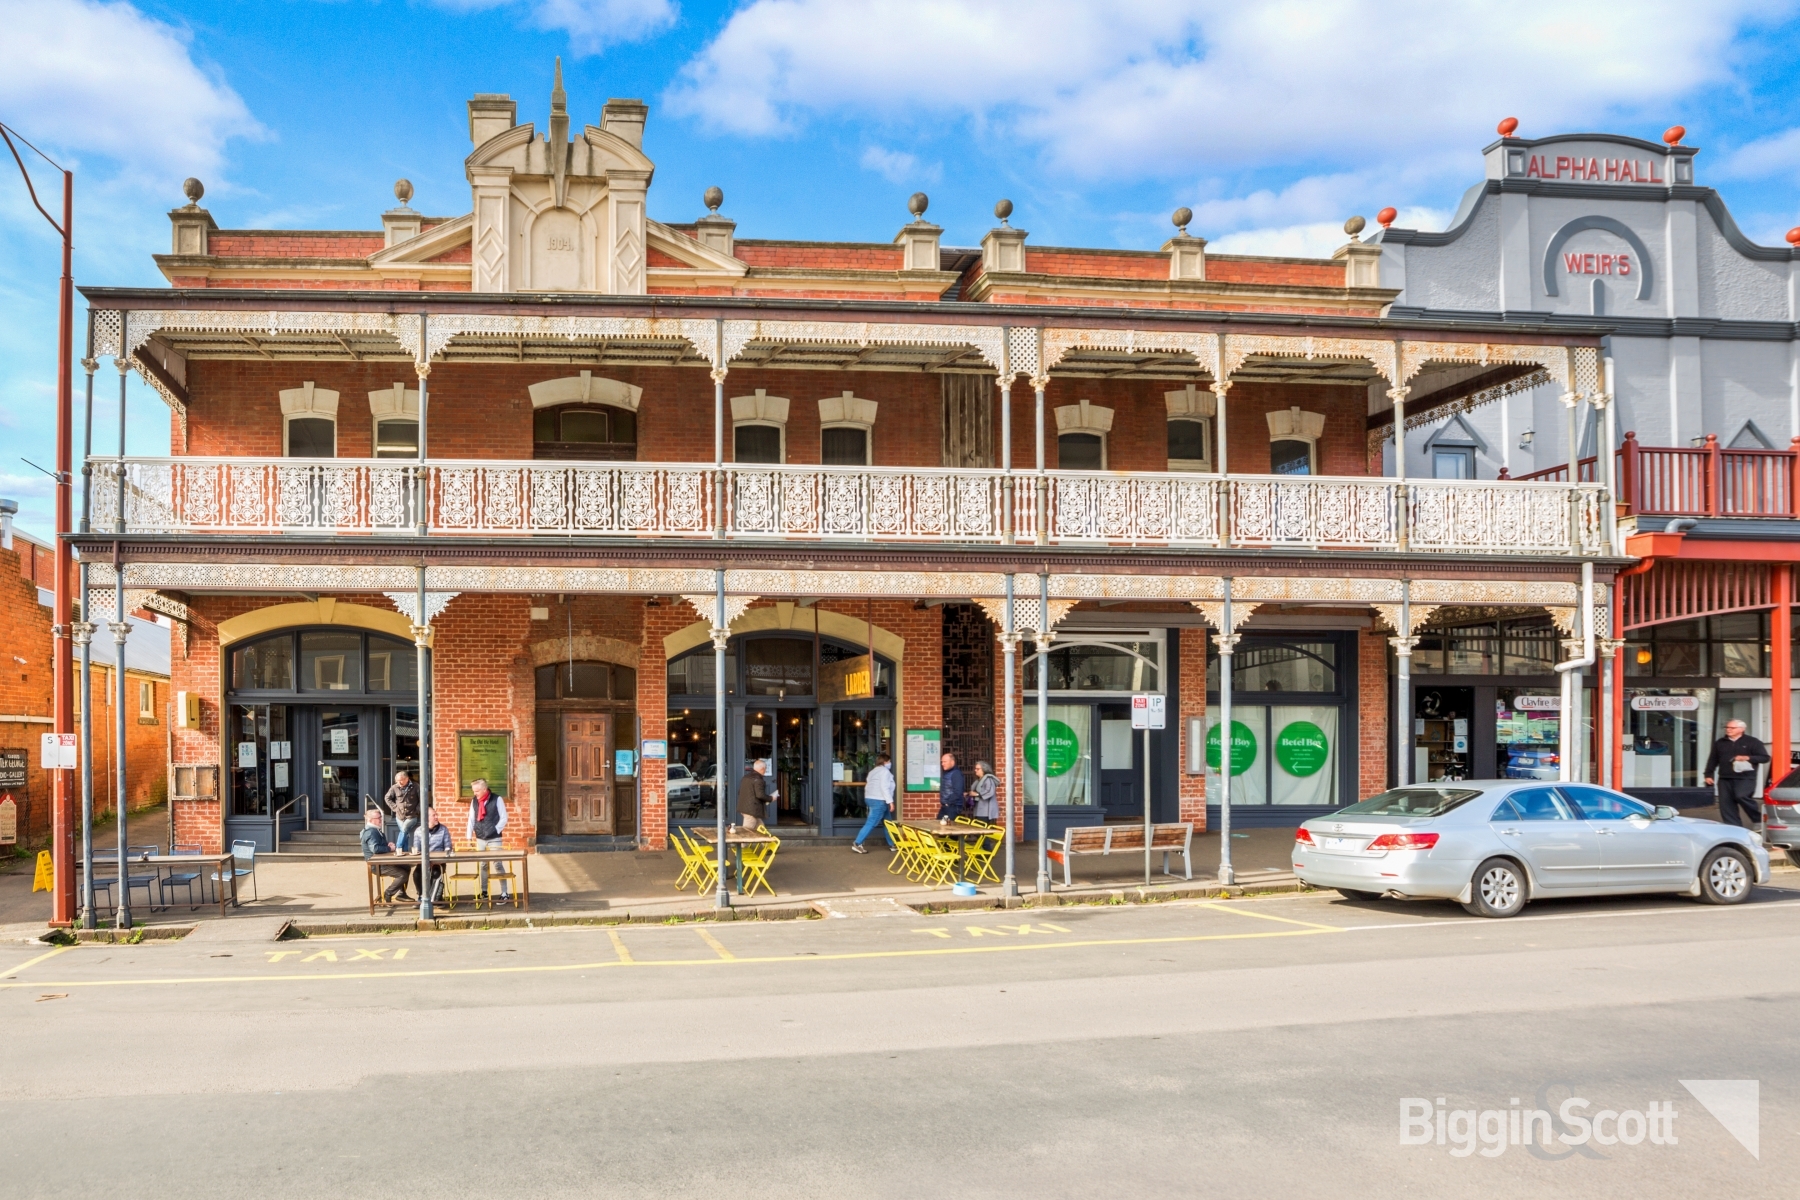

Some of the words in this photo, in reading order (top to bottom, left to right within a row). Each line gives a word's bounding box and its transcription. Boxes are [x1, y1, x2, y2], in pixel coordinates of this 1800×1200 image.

[1527, 155, 1600, 181] ALPHA
[1603, 158, 1663, 183] HALL
[1563, 253, 1631, 275] WEIR'S
[845, 670, 870, 695] LARDER
[1521, 697, 1550, 707] Clayfire
[1638, 697, 1667, 707] Clayfire
[1056, 737, 1073, 748] Boy
[1234, 738, 1251, 748] Boy
[1282, 738, 1305, 747] Betel
[1306, 739, 1323, 749] Boy
[911, 923, 1072, 938] TAXI
[264, 949, 409, 963] TAXI
